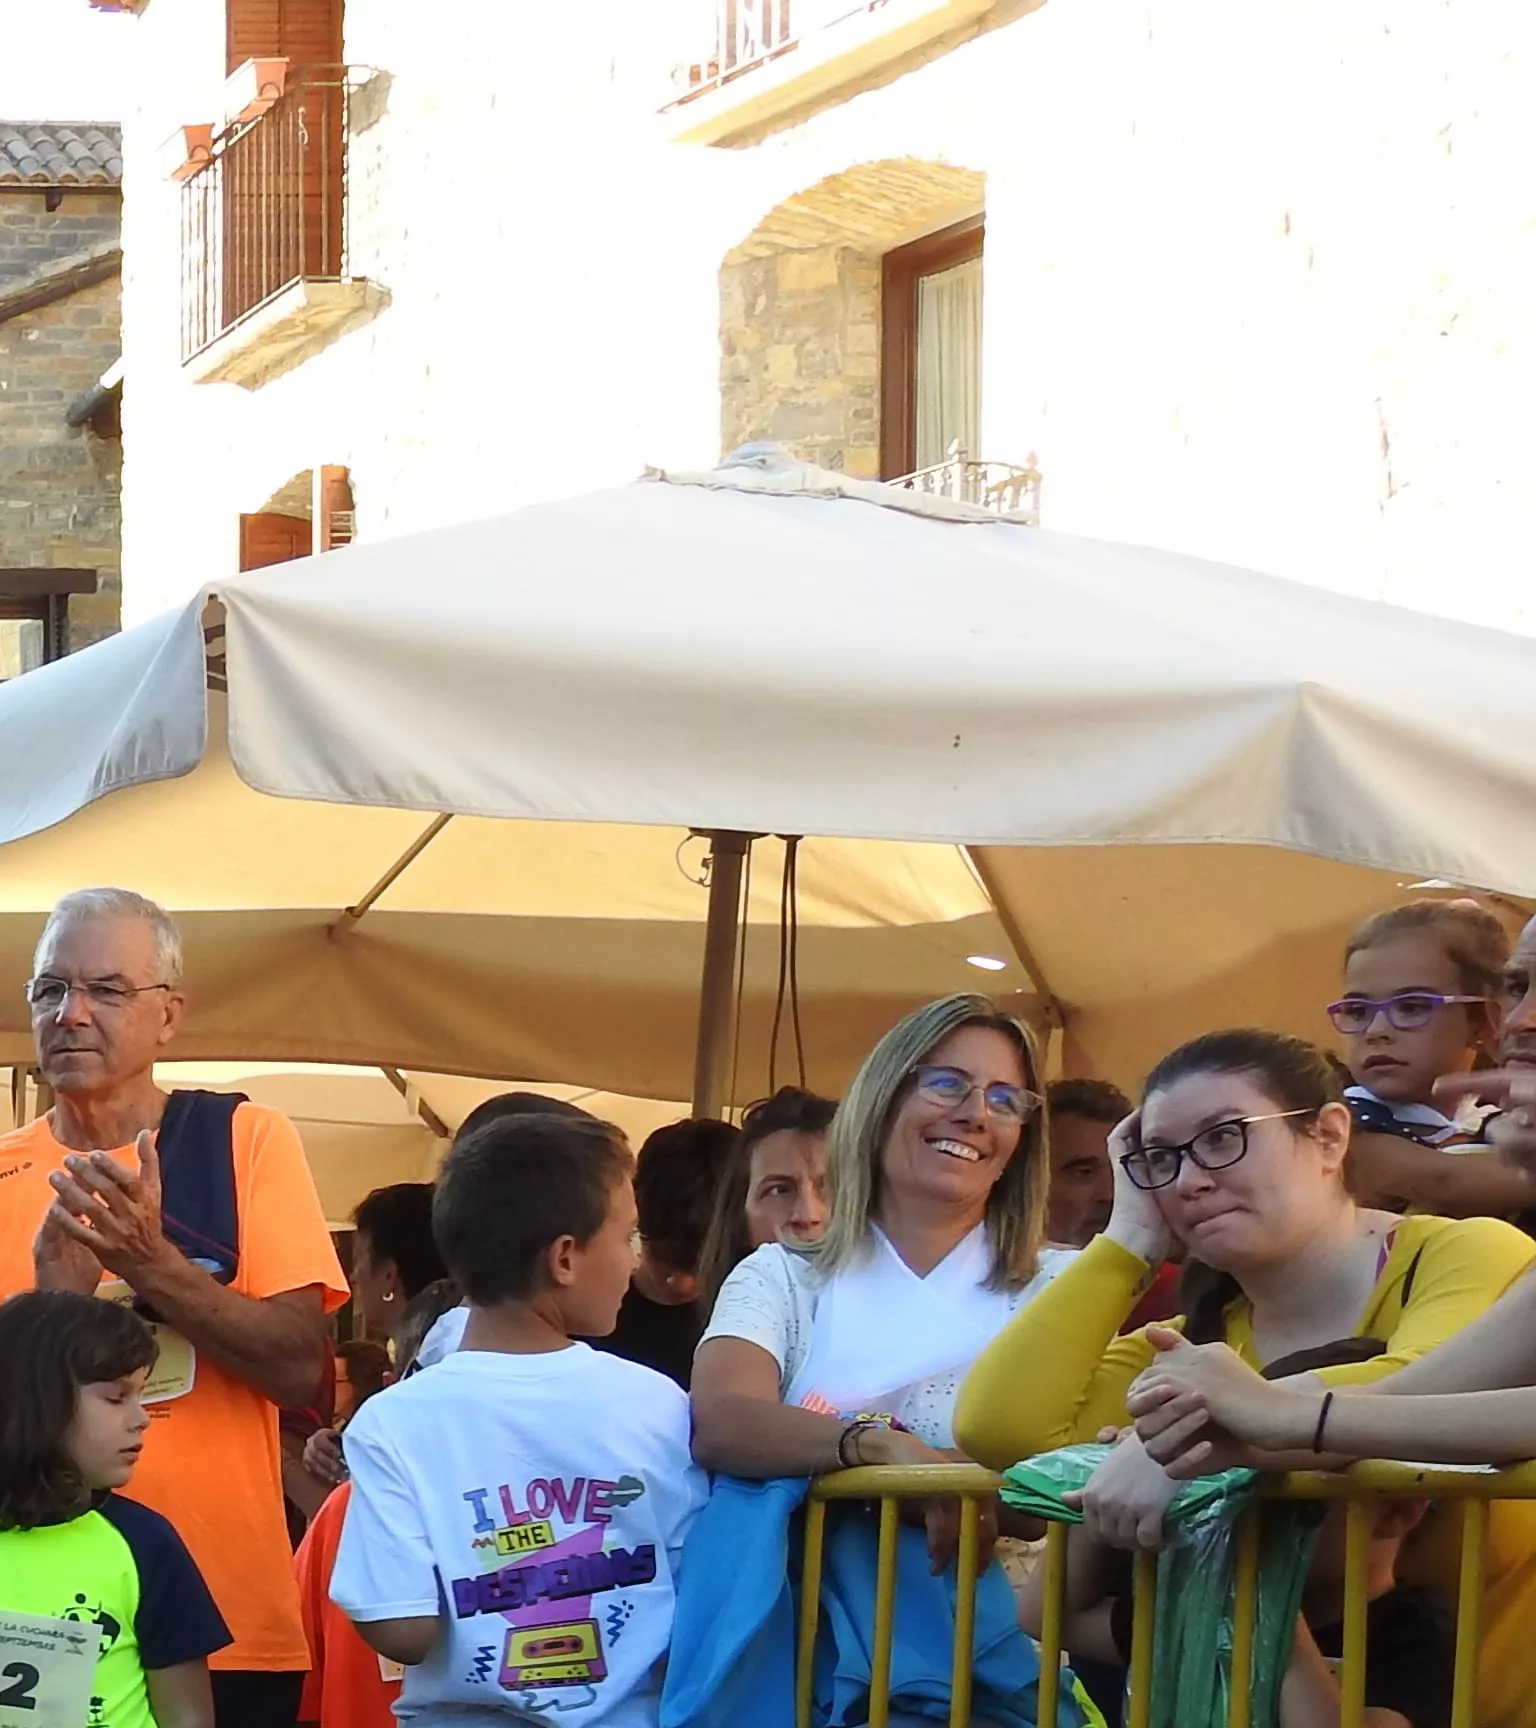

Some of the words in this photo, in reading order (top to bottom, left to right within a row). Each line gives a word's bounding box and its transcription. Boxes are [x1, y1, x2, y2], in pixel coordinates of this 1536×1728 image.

[462, 1487, 496, 1534] I
[498, 1477, 620, 1527] LOVE
[497, 1524, 548, 1551] THE
